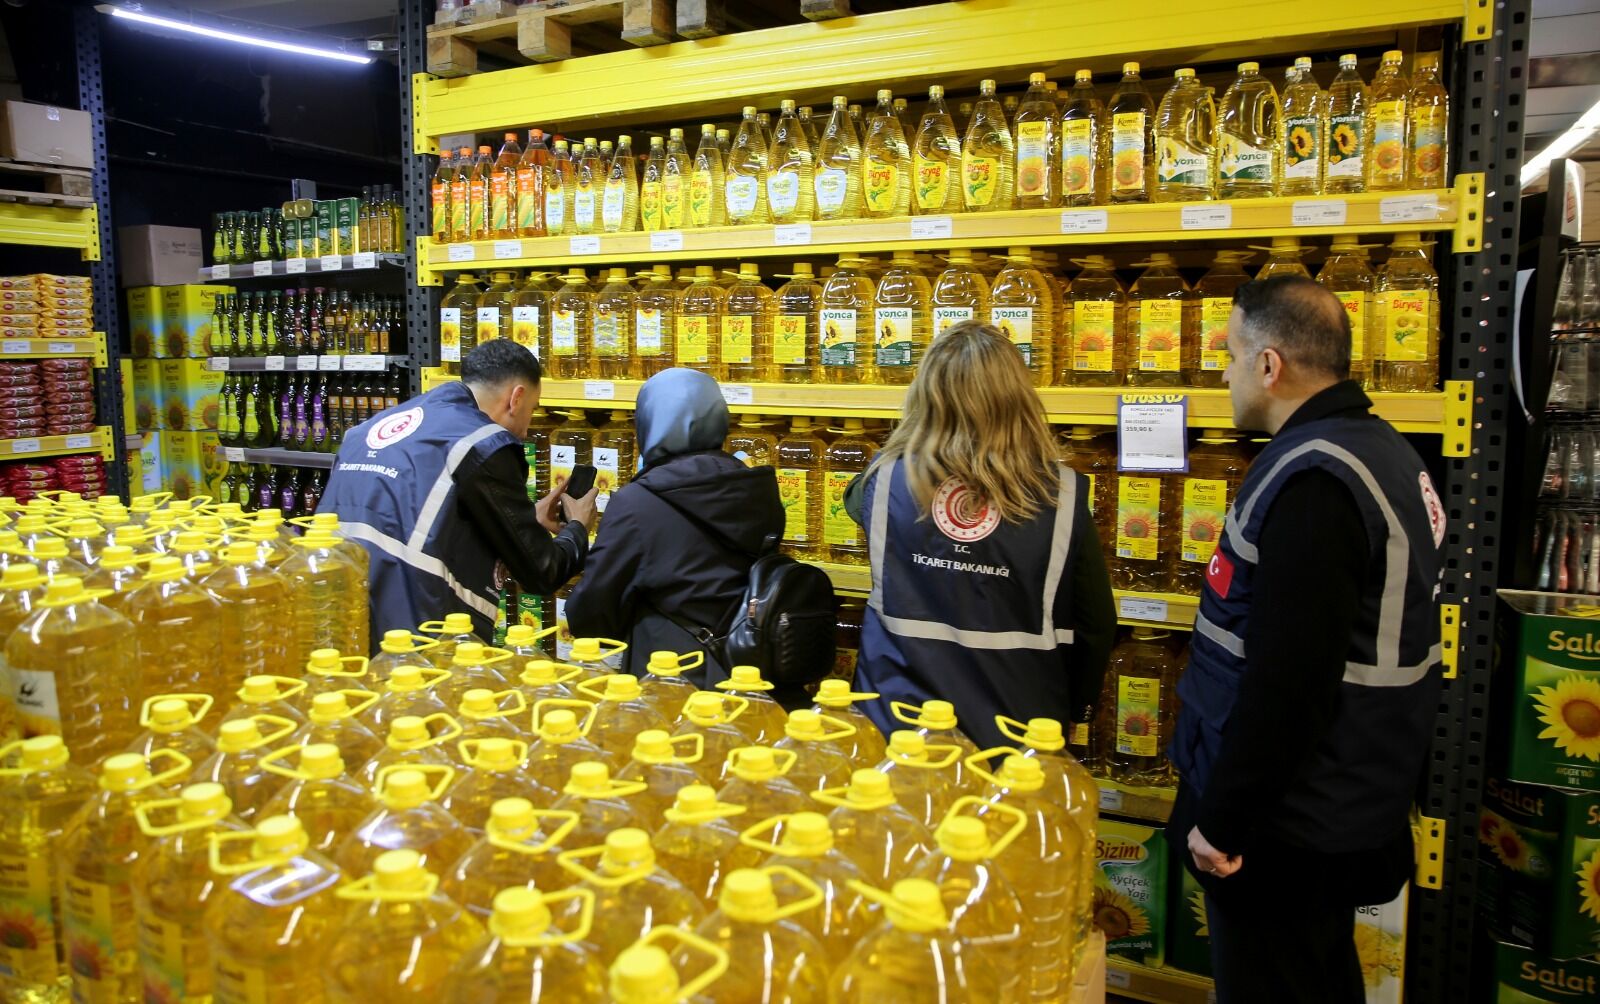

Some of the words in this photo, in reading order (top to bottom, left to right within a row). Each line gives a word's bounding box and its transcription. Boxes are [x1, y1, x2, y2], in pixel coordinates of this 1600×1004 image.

[1287, 117, 1316, 127] yonca
[1331, 115, 1360, 125] yonca
[1235, 153, 1268, 163] yonca
[823, 311, 853, 320] yonca
[878, 309, 908, 319] yonca
[937, 309, 969, 319] yonca
[995, 310, 1028, 319] yonca
[952, 543, 971, 554] T.C.
[912, 553, 953, 569] TİCARET
[953, 561, 1010, 578] BAKANLIĞI
[1487, 777, 1544, 817] Salat
[1096, 839, 1141, 860] Bizim
[1110, 873, 1151, 887] Ayçiçek
[1127, 887, 1149, 901] Yağı
[1520, 960, 1597, 994] Salat
